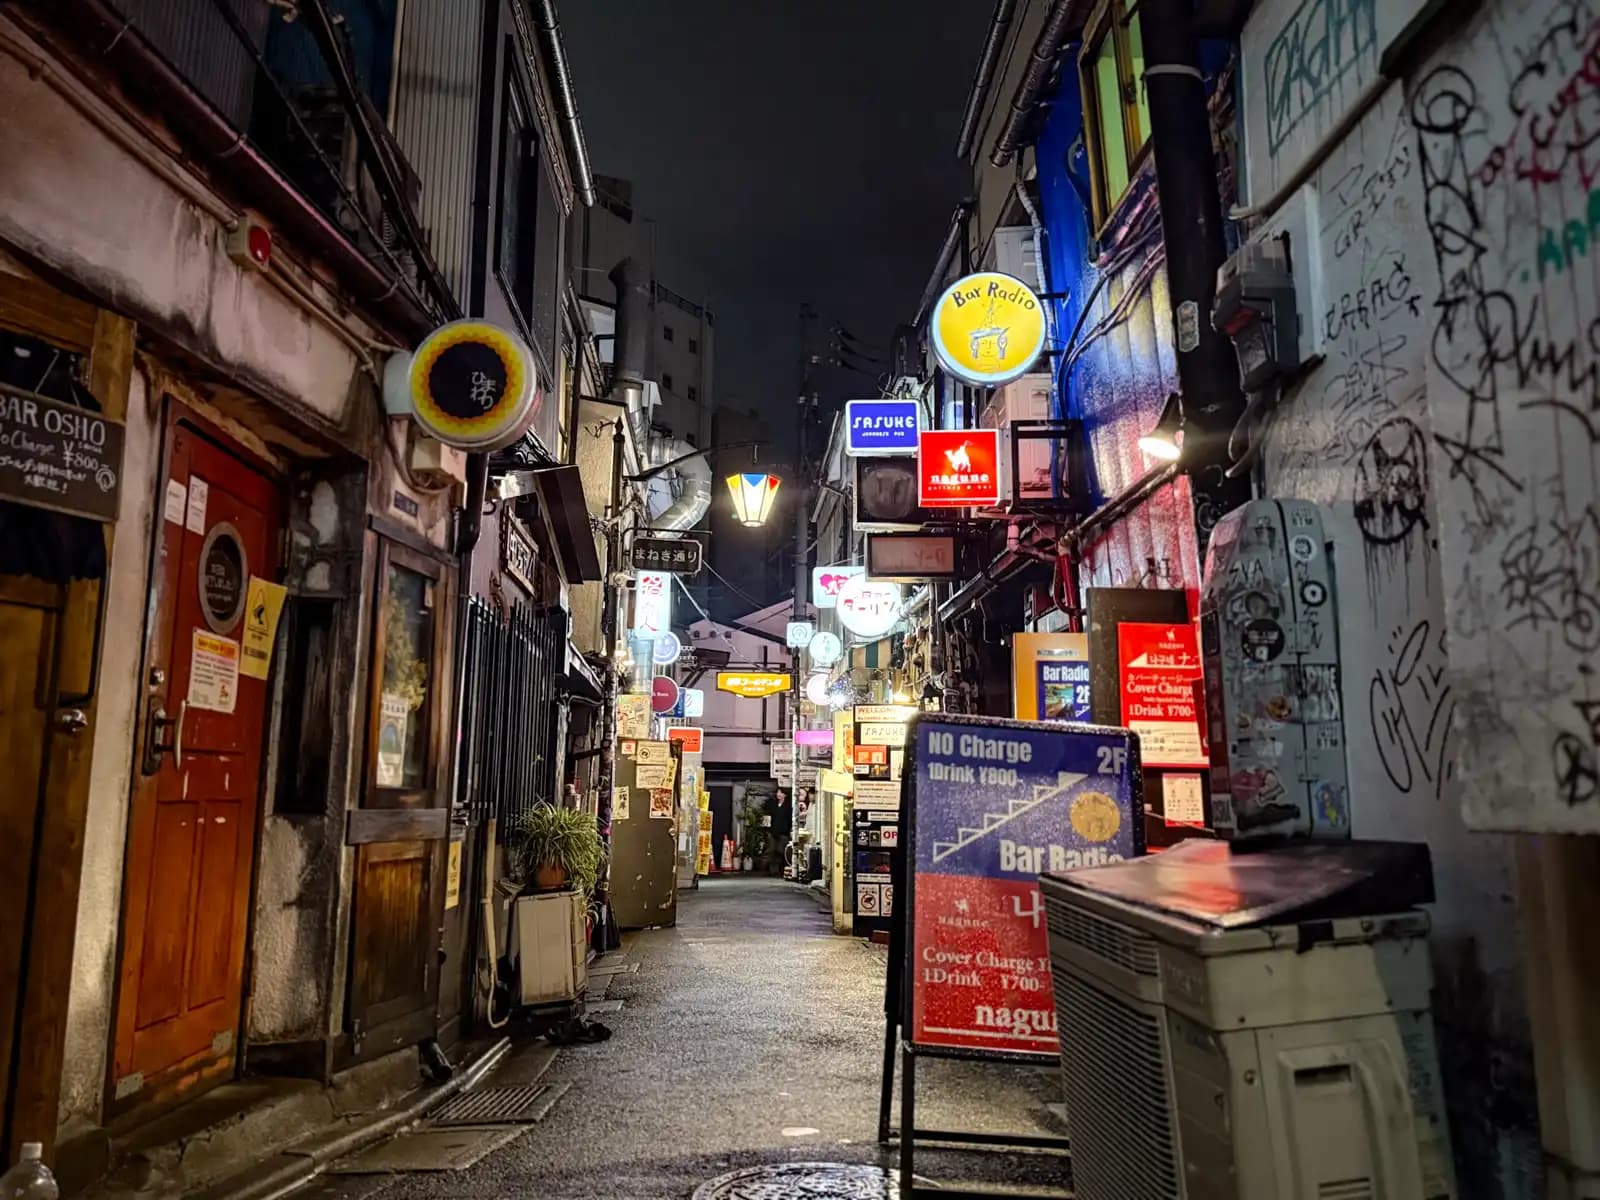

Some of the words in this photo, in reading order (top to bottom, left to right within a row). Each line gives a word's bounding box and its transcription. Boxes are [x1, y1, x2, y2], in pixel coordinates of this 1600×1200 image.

[952, 287, 981, 308] Bar
[987, 281, 1036, 311] Radio
[470, 371, 497, 410] ひまわり
[0, 394, 39, 428] BAR
[43, 409, 106, 446] OSHO
[852, 415, 915, 429] SASUKE
[930, 473, 990, 484] nagune
[635, 549, 697, 563] まねき通り
[1043, 665, 1060, 682] Bar
[1062, 665, 1089, 682] Radio
[1127, 682, 1157, 695] Cover
[1129, 704, 1163, 717] 1Drink
[928, 731, 954, 755] NO
[959, 734, 1033, 764] Charge
[1097, 746, 1128, 774] 2F
[928, 762, 976, 783] 1Drink
[1000, 839, 1045, 874] Bar
[922, 947, 973, 965] Cover
[976, 951, 1034, 974] Charge
[923, 967, 982, 987] 1Drink
